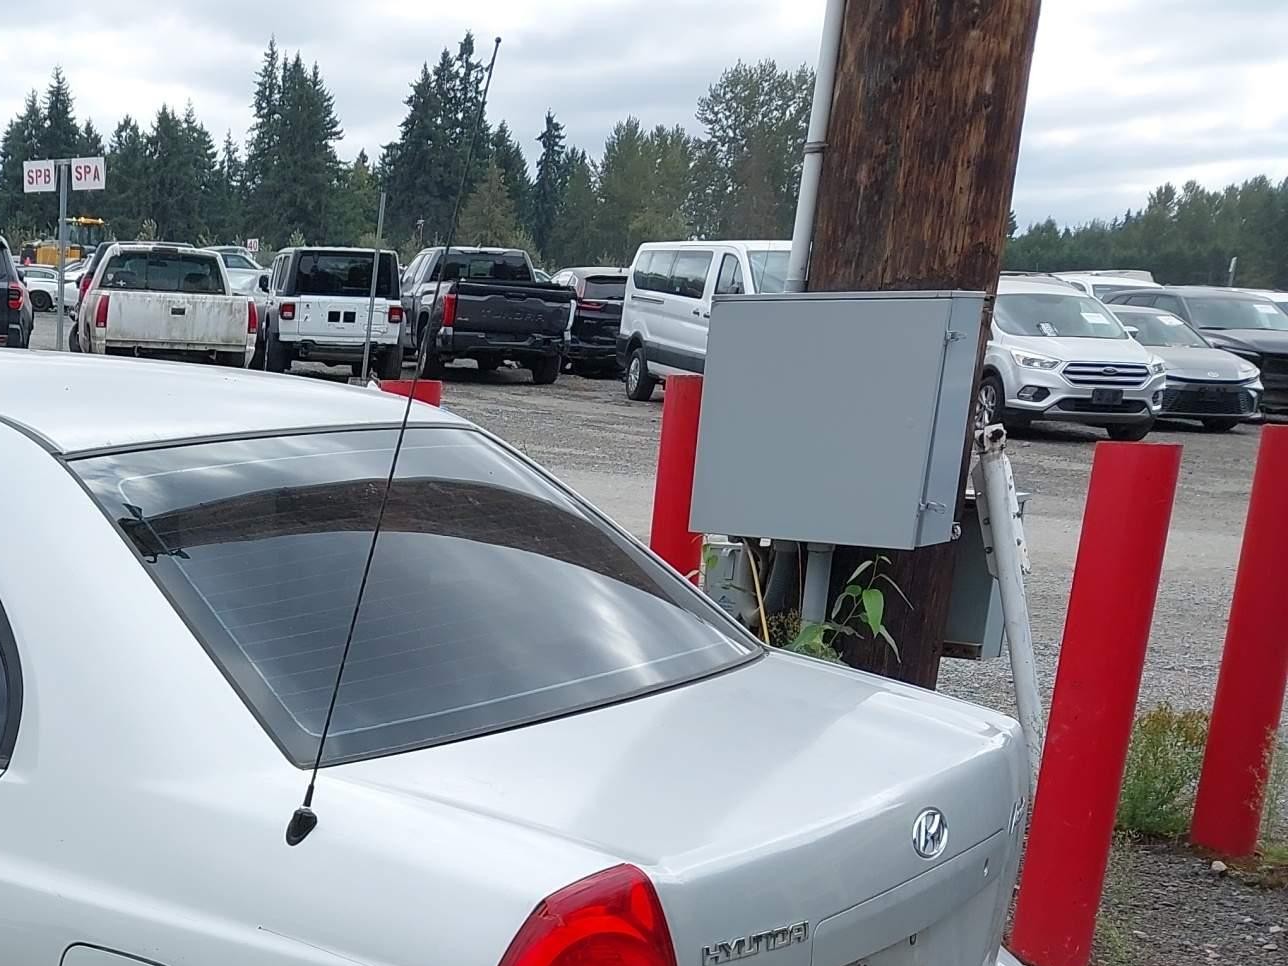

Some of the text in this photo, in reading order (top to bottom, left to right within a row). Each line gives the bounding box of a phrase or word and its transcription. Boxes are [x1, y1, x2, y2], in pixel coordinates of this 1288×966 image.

[27, 168, 52, 185] SPB
[74, 164, 100, 182] SPA
[247, 239, 258, 251] 40
